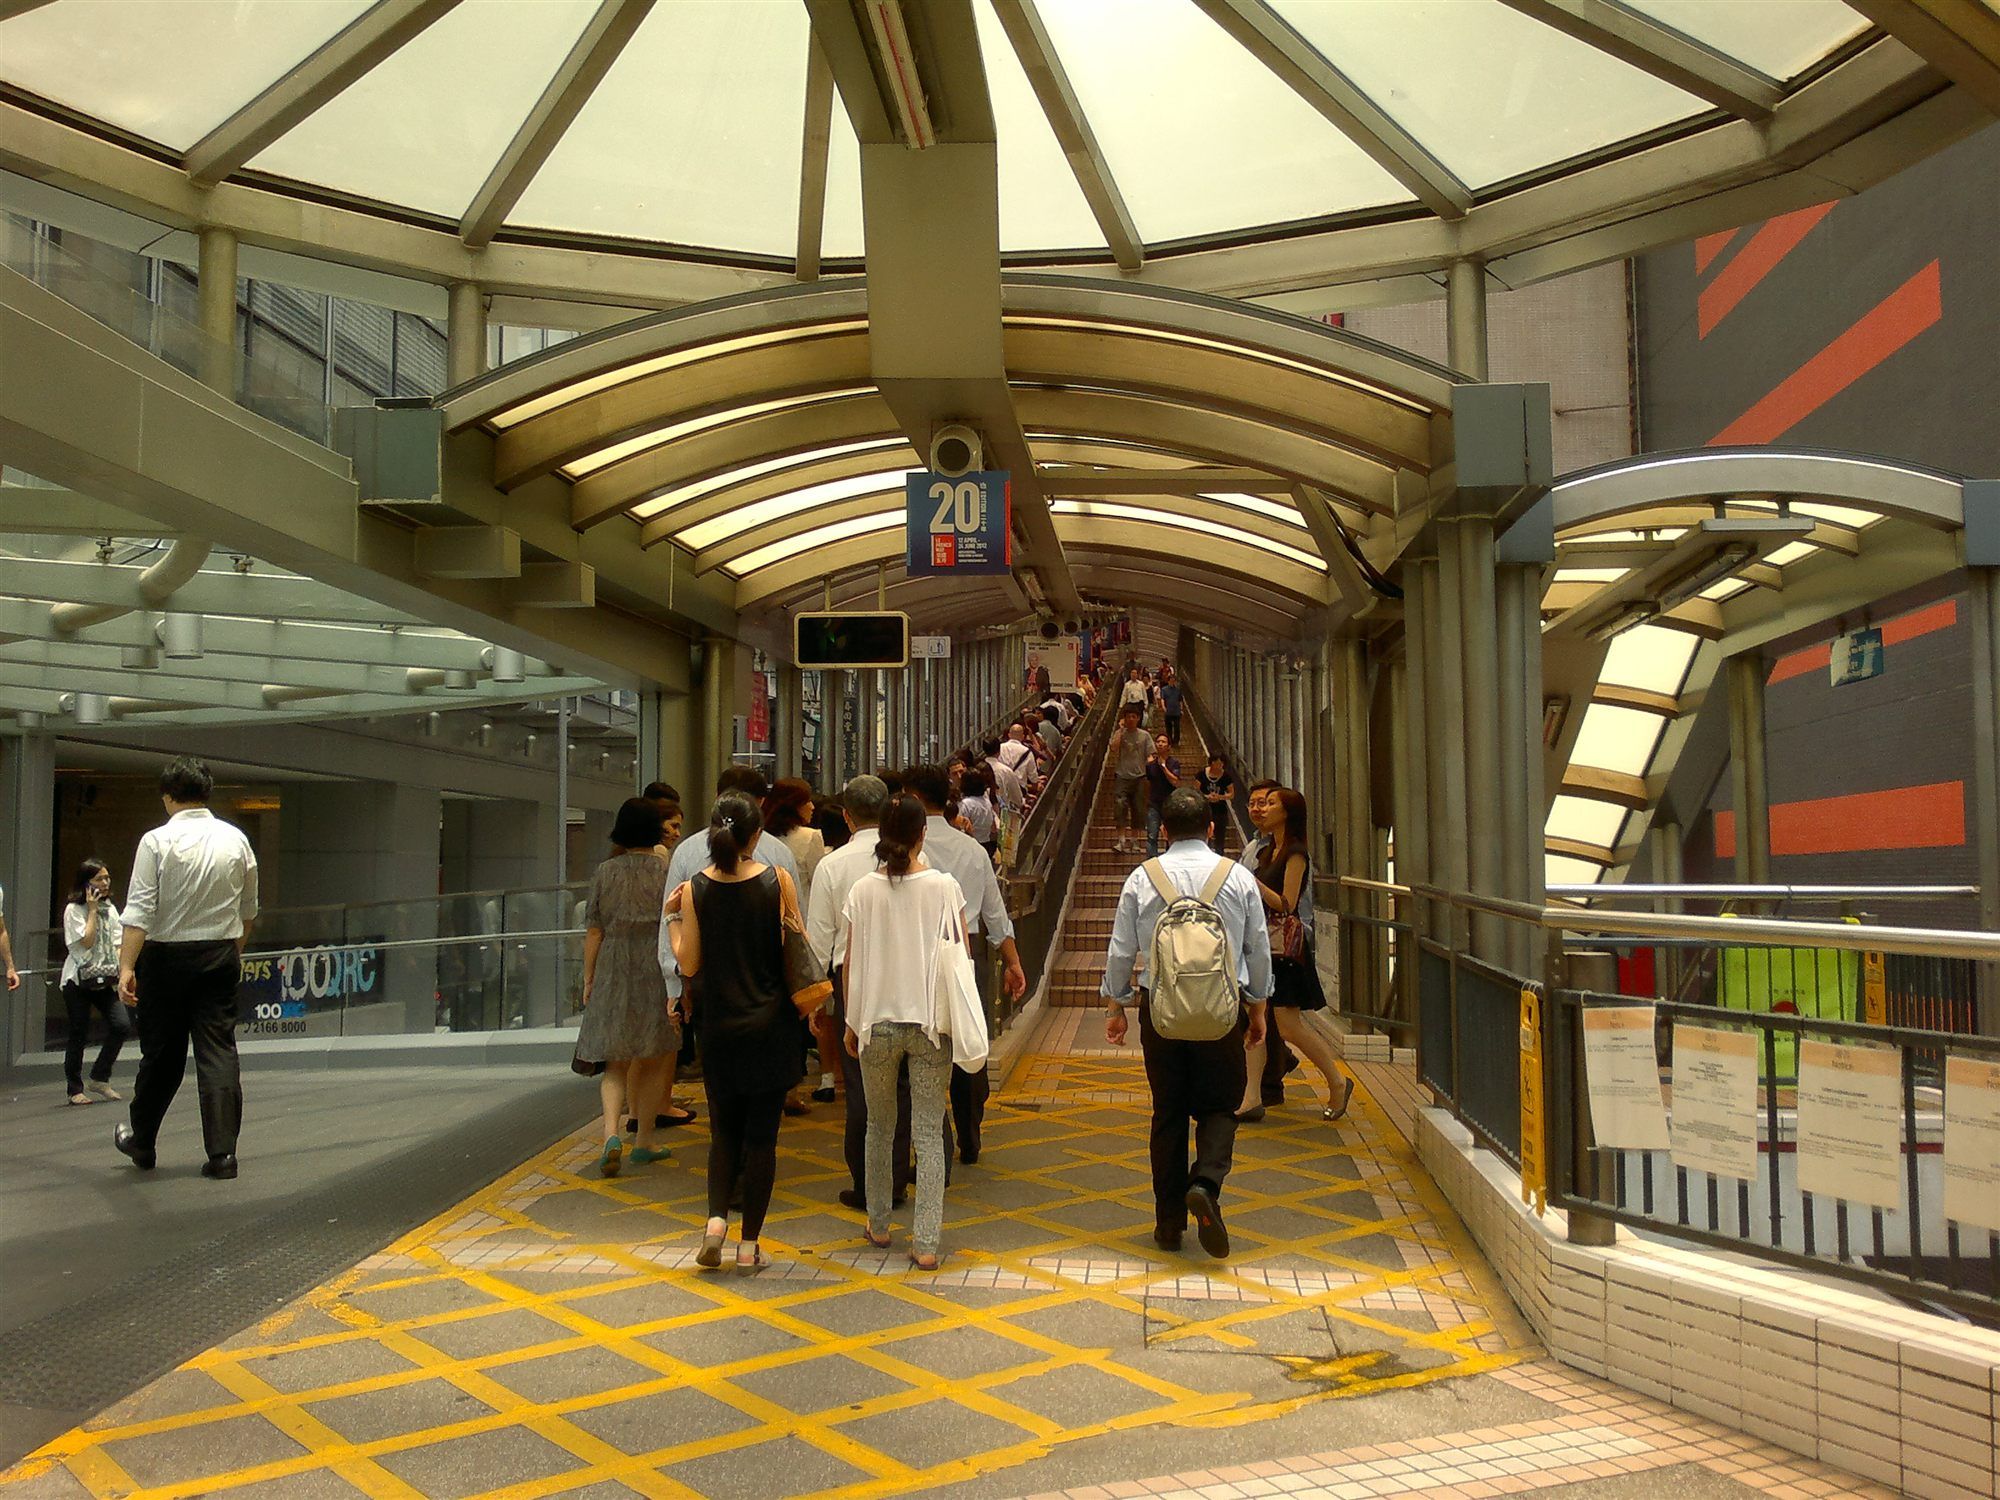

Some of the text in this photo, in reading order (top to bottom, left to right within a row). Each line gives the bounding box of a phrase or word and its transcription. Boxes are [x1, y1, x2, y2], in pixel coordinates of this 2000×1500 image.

[928, 481, 980, 533] 20
[254, 1003, 282, 1019] 100
[253, 1021, 307, 1033] 2166 8000
